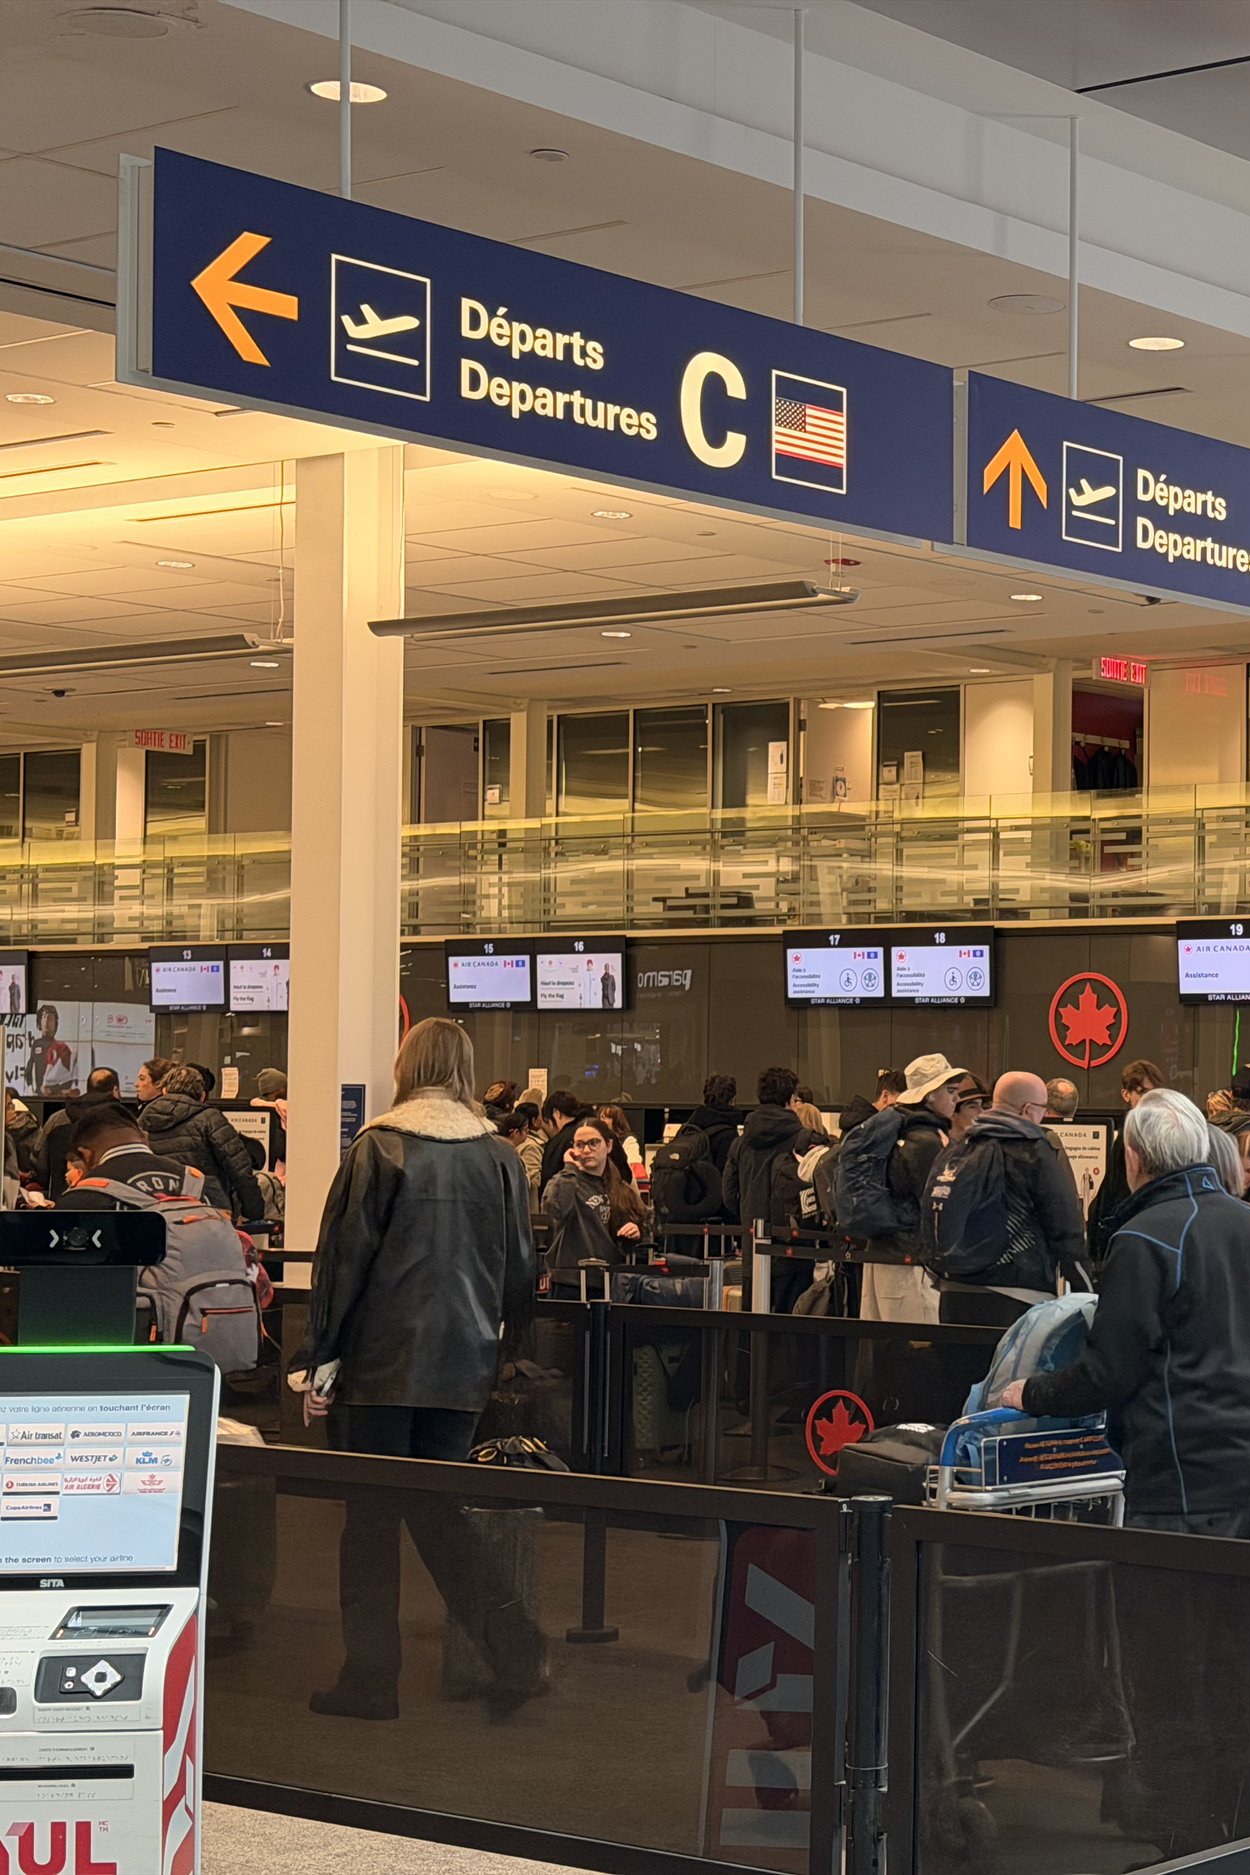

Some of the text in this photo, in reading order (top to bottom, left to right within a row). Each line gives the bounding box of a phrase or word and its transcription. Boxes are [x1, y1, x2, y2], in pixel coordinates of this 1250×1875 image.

[461, 297, 604, 370] Départs
[461, 358, 657, 441] Departures
[681, 352, 747, 468] C
[1137, 469, 1227, 521] Départs
[1130, 662, 1147, 684] EXIT
[169, 733, 187, 750] EXIT
[1229, 923, 1244, 936] 19
[829, 934, 841, 946] 17
[934, 932, 946, 944] 18
[484, 943, 494, 954] 15
[574, 941, 584, 952] 16
[1196, 944, 1250, 953] AIR CANADA
[183, 950, 192, 960] 13
[263, 948, 272, 958] 14
[1184, 971, 1219, 979] Assistance
[20, 1431, 62, 1440] Air transat
[70, 1454, 108, 1464] WESTJET
[5, 1556, 19, 1564] the
[40, 1579, 65, 1588] SITA
[0, 1821, 117, 1875] UL
